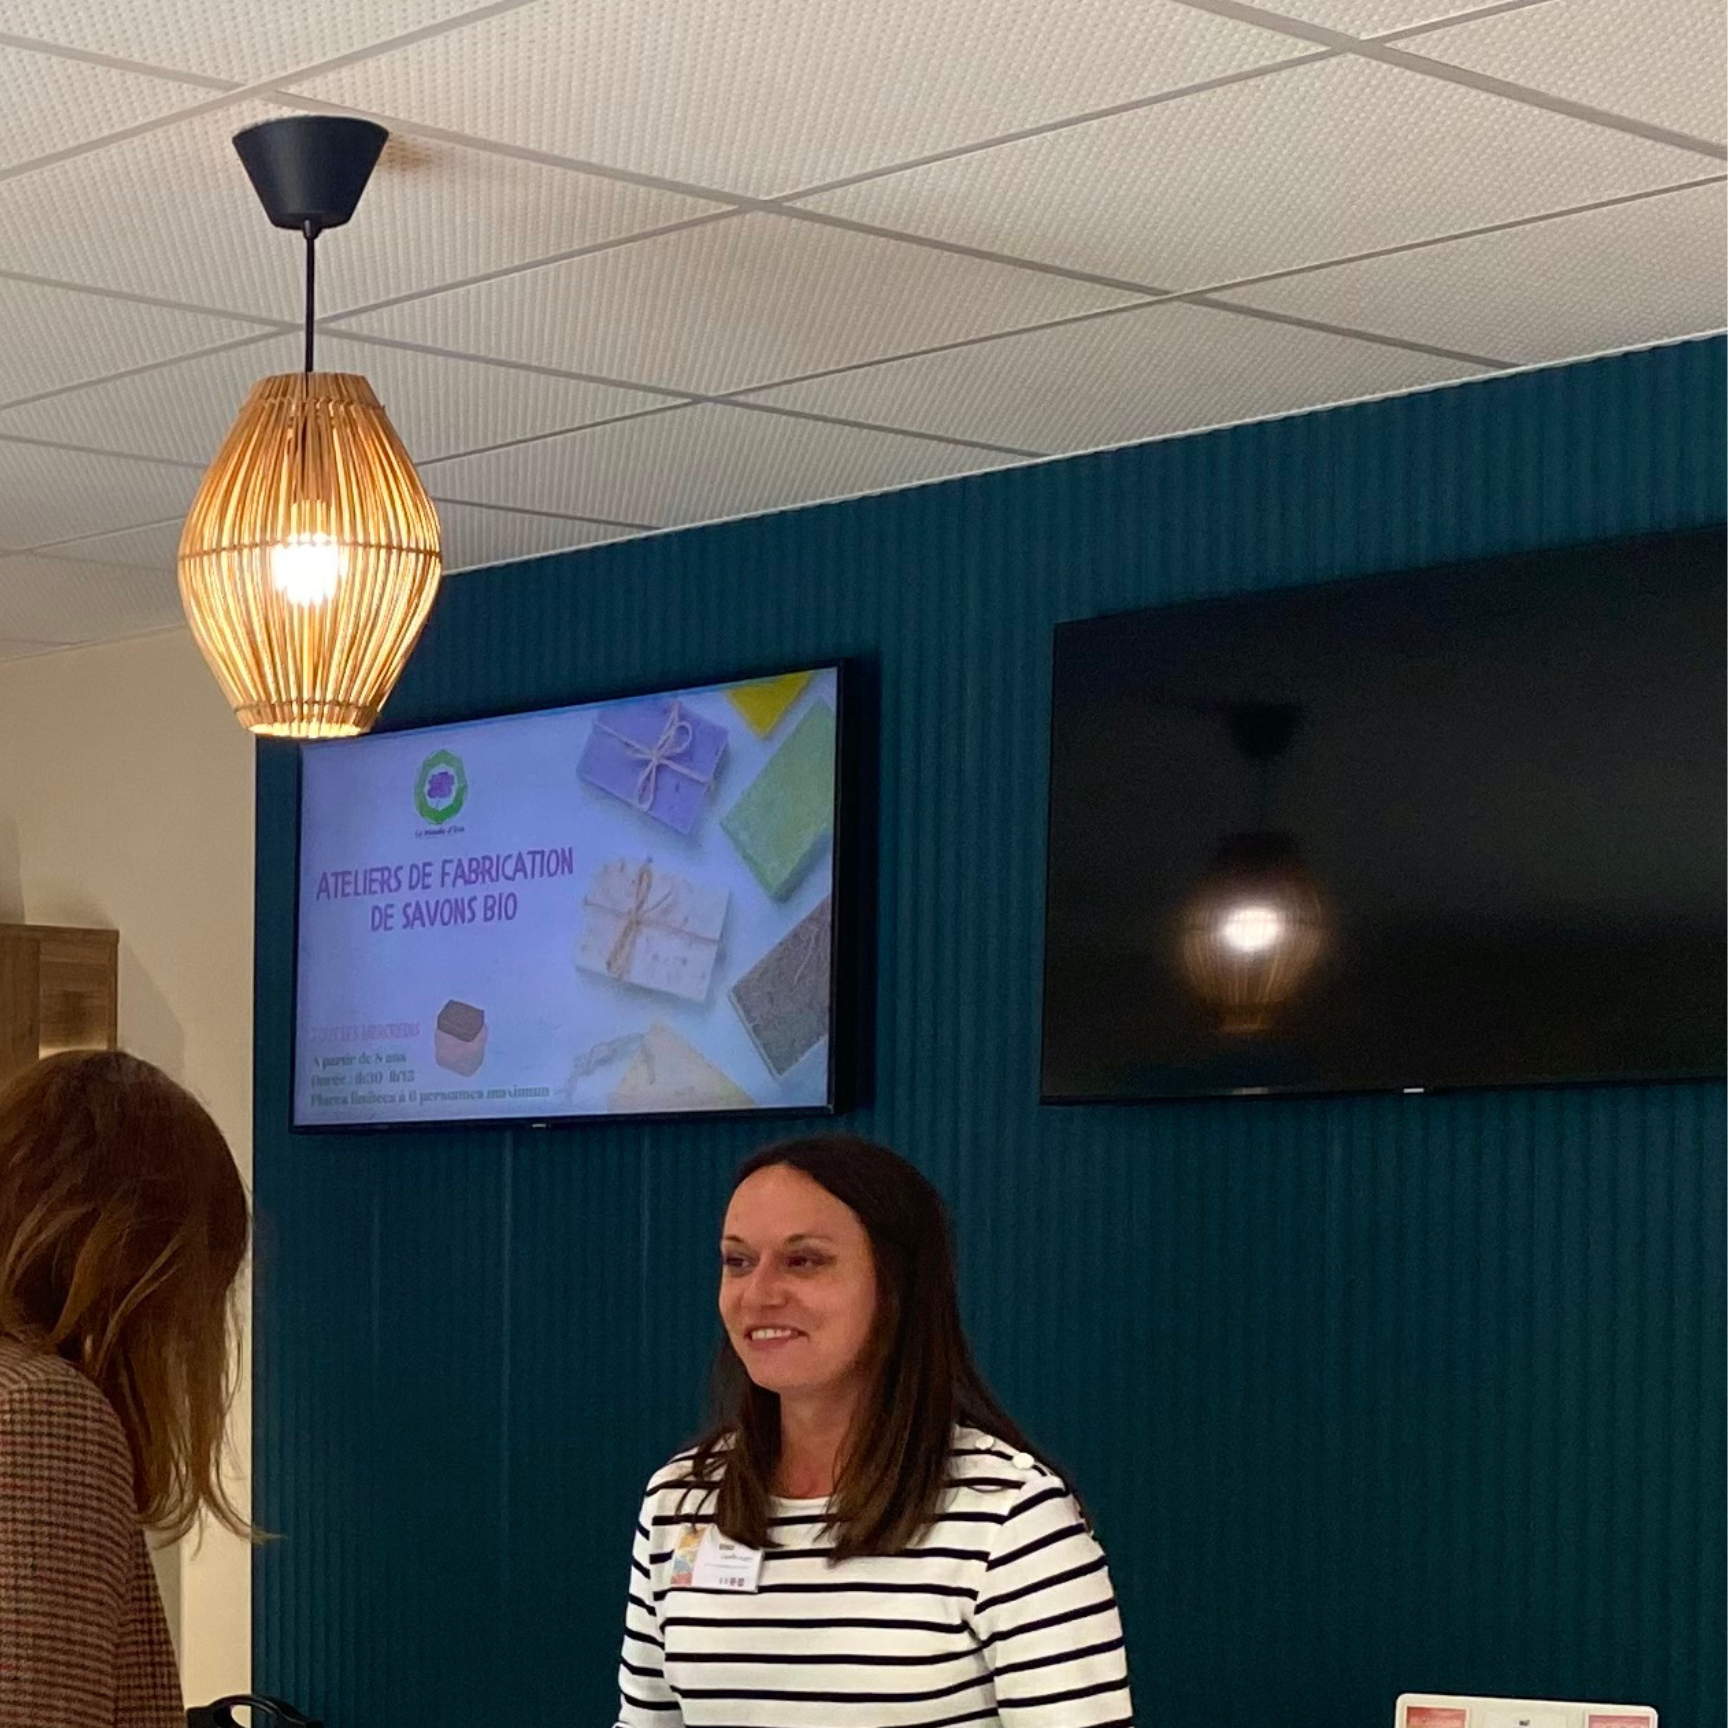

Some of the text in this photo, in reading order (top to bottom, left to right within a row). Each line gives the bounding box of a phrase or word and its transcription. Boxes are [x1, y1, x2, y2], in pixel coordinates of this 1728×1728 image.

[316, 846, 574, 901] ATELIERS DE FABRICATION
[371, 892, 518, 931] DE SAVONS BIO
